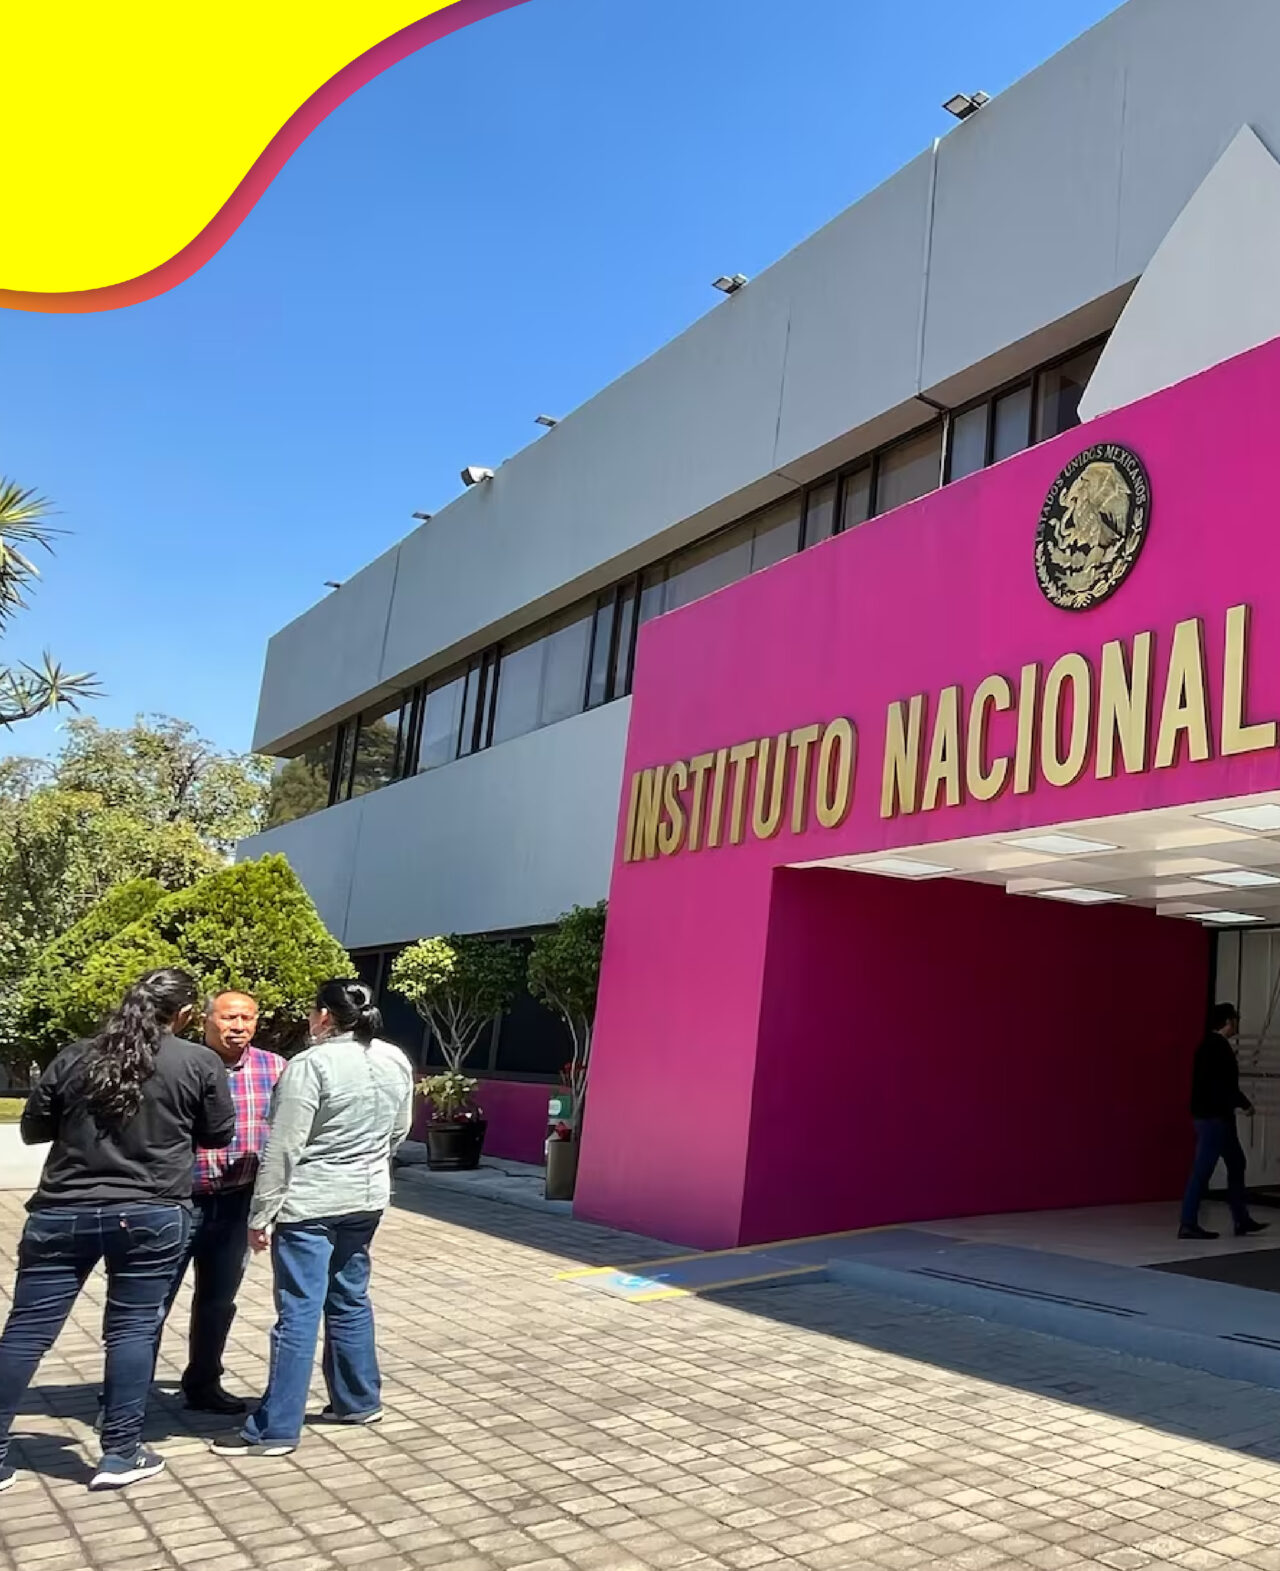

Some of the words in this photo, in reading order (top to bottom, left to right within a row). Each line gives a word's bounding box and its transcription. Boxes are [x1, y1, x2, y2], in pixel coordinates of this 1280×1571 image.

[1064, 446, 1104, 477] UNIDOS
[1105, 444, 1147, 505] MEXICANOS
[623, 716, 857, 863] INSTITUTO
[880, 603, 1280, 819] NACIONAL
